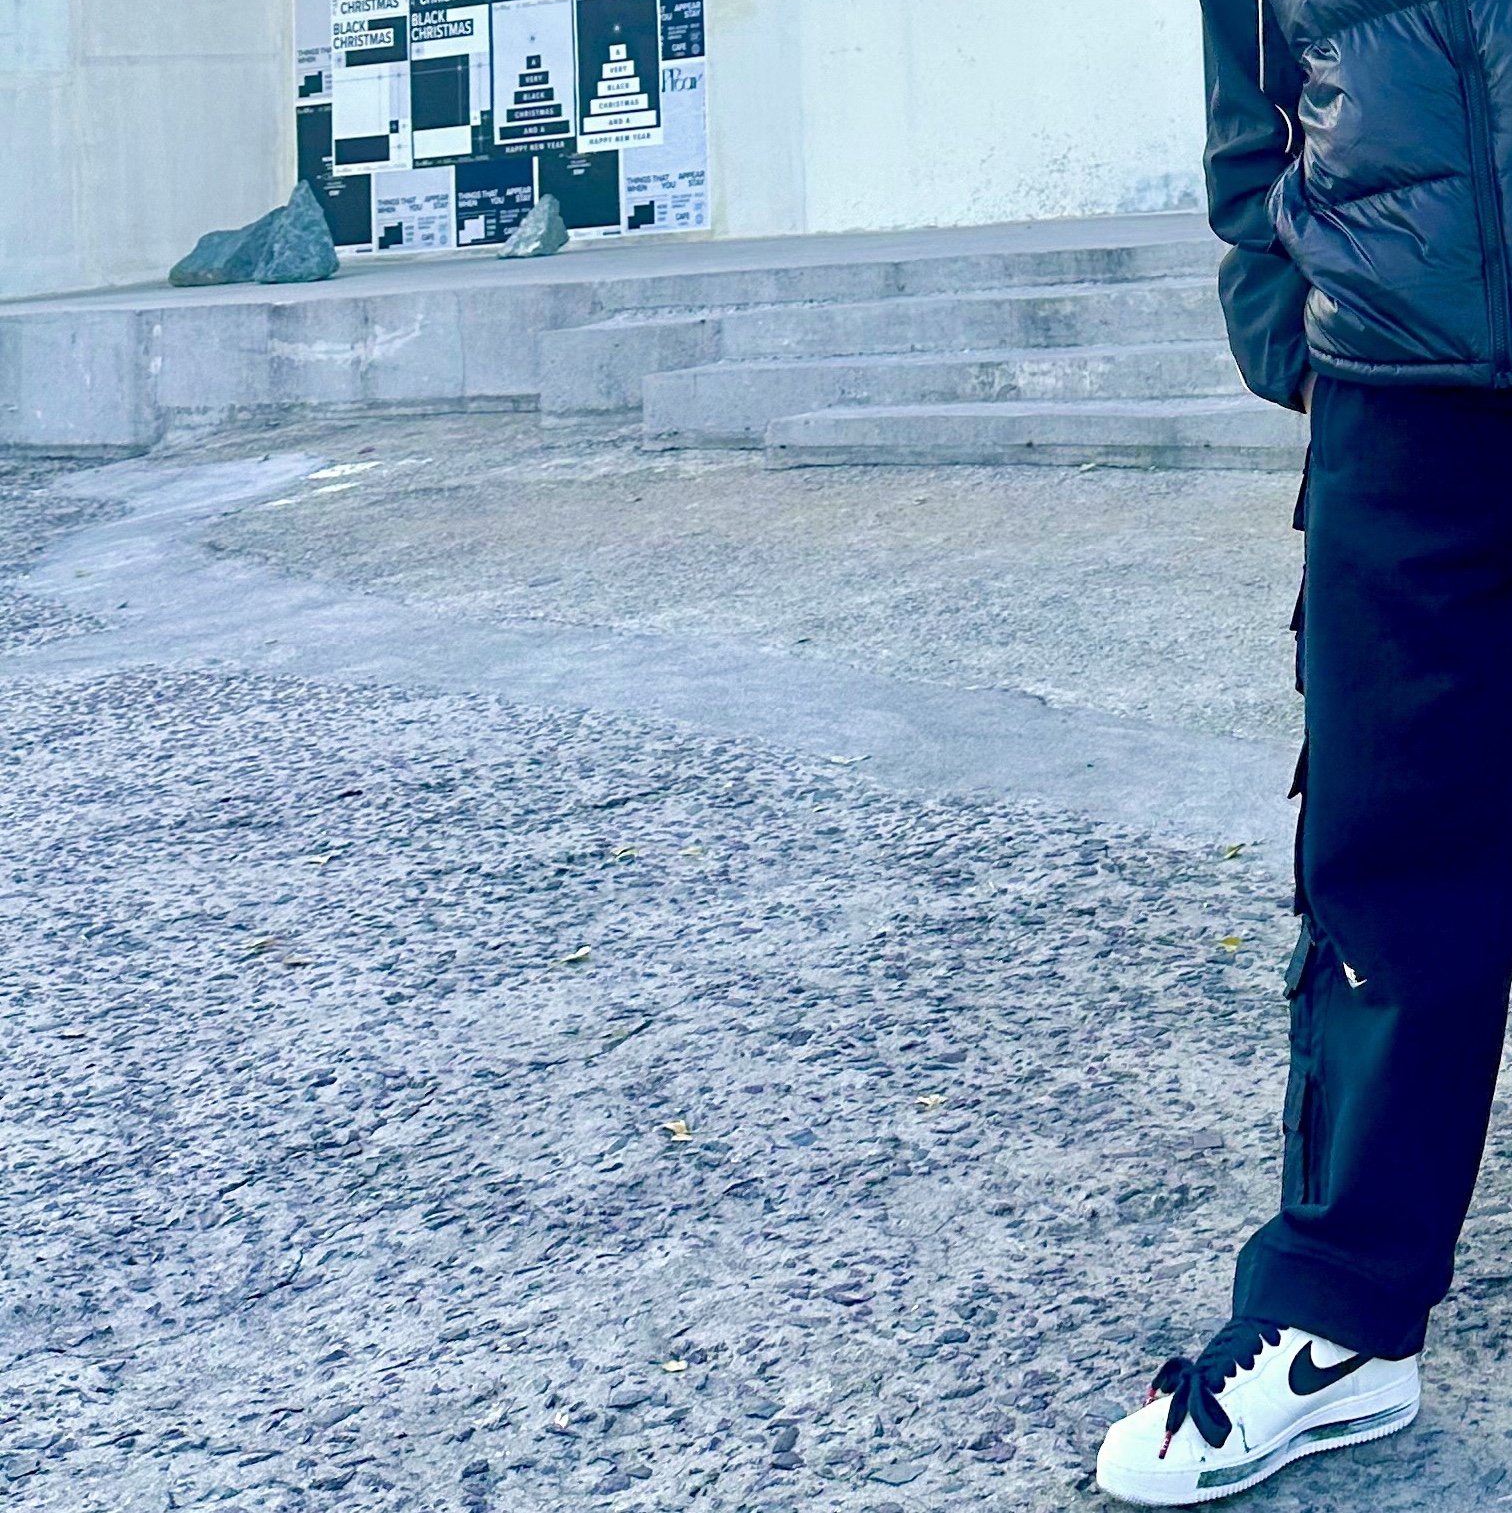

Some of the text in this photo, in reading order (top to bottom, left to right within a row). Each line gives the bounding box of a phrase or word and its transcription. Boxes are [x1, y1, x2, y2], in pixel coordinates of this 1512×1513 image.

[411, 10, 445, 27] BLACK
[333, 20, 366, 35] BLACK
[411, 21, 472, 41] CHRISTMAS
[333, 31, 392, 49] CHRISTMAS
[607, 83, 630, 92] BLACK
[522, 92, 545, 101] BLACK
[599, 99, 640, 110] CHRISTMAS
[514, 108, 555, 119] CHRISTMAS
[524, 127, 538, 135] AND
[590, 133, 651, 145] HAPPY NEW YEAR
[506, 141, 565, 154] HAPPY NEW YEAR
